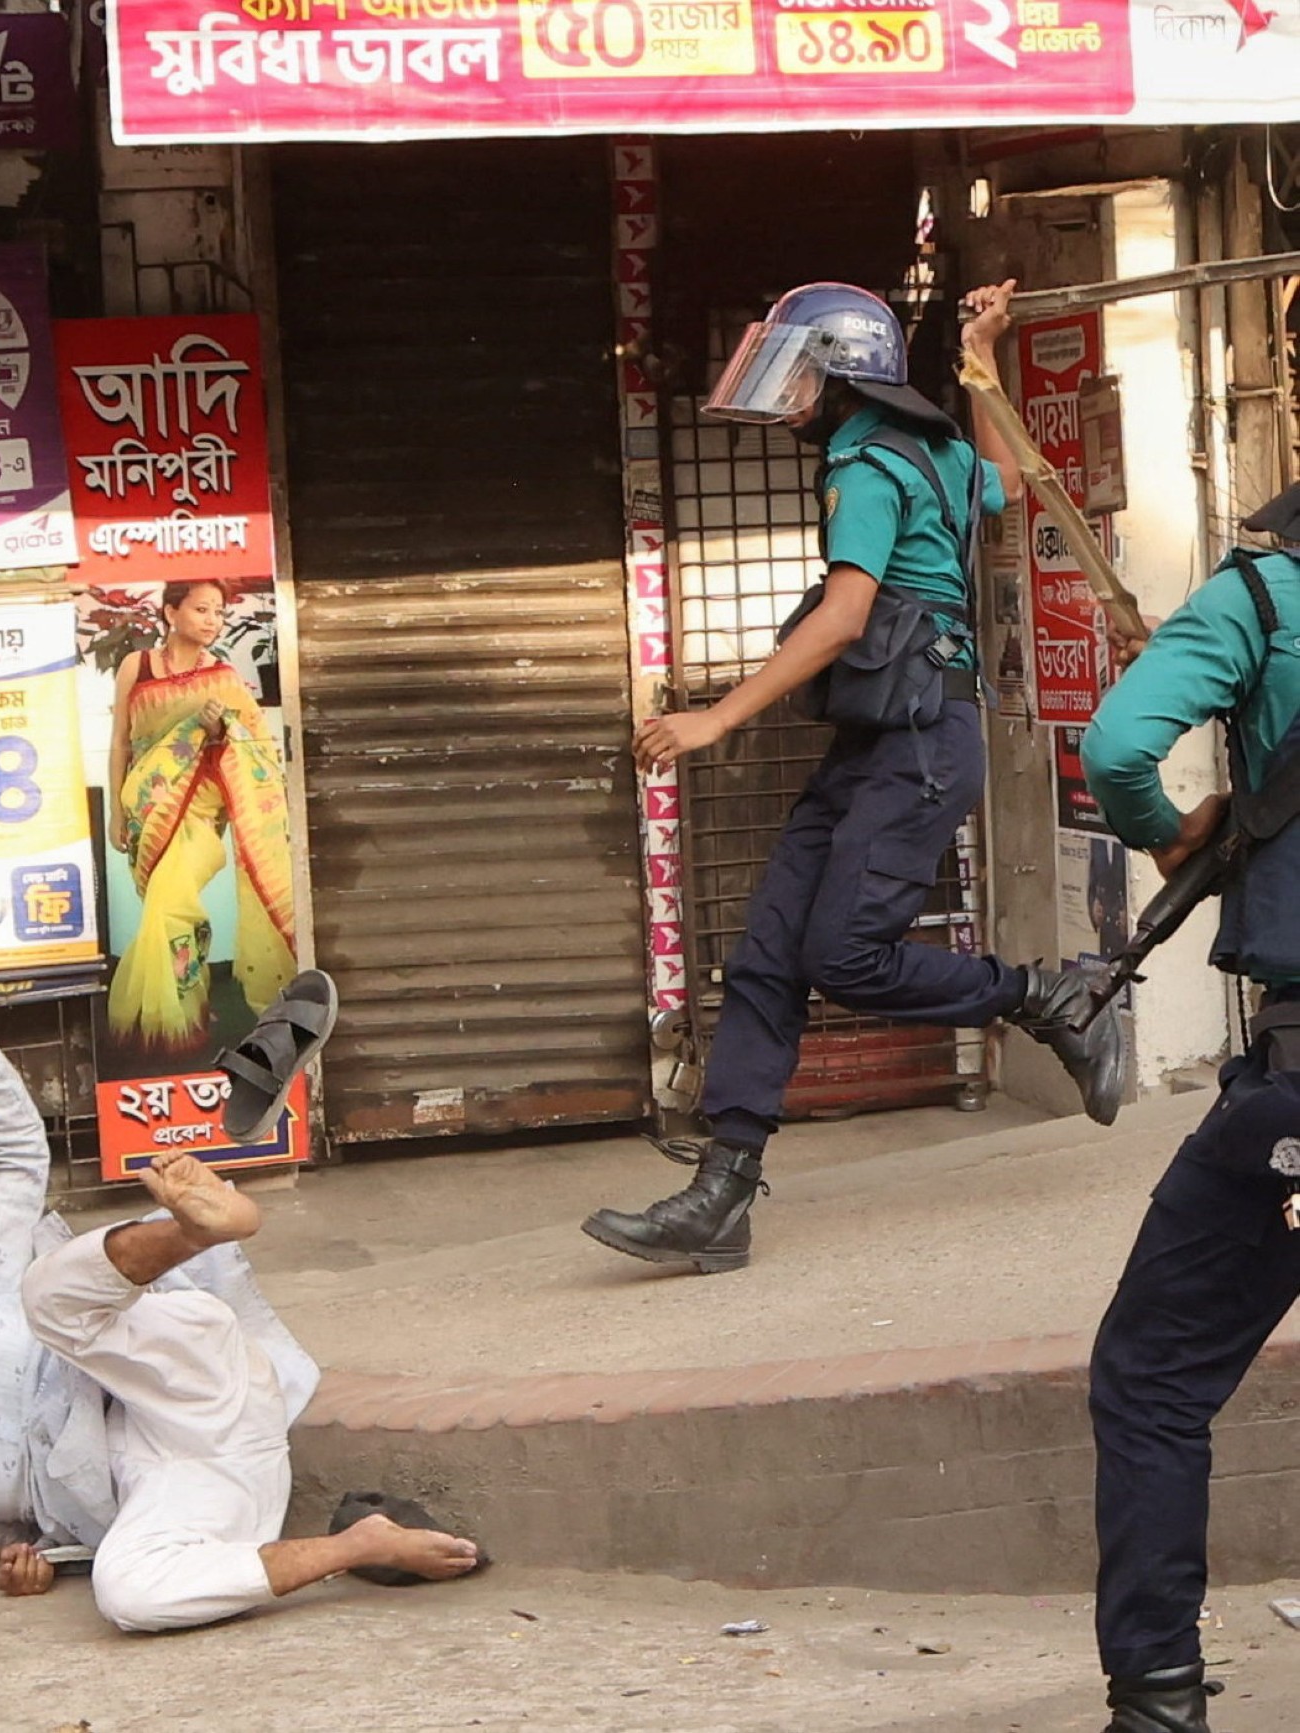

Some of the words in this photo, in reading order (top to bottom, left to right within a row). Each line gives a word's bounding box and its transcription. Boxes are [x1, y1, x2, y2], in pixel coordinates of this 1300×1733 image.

[650, 2, 739, 31] হাজার
[146, 13, 320, 94] সুবিধা
[332, 28, 500, 83] ডাবল
[844, 317, 887, 336] POLICE
[72, 334, 249, 438] আদি
[76, 433, 237, 505] মনিপুরী
[1037, 627, 1090, 680] উত্তরণ
[117, 1081, 175, 1123] ২য়
[153, 1122, 213, 1145] প্রবেশ
